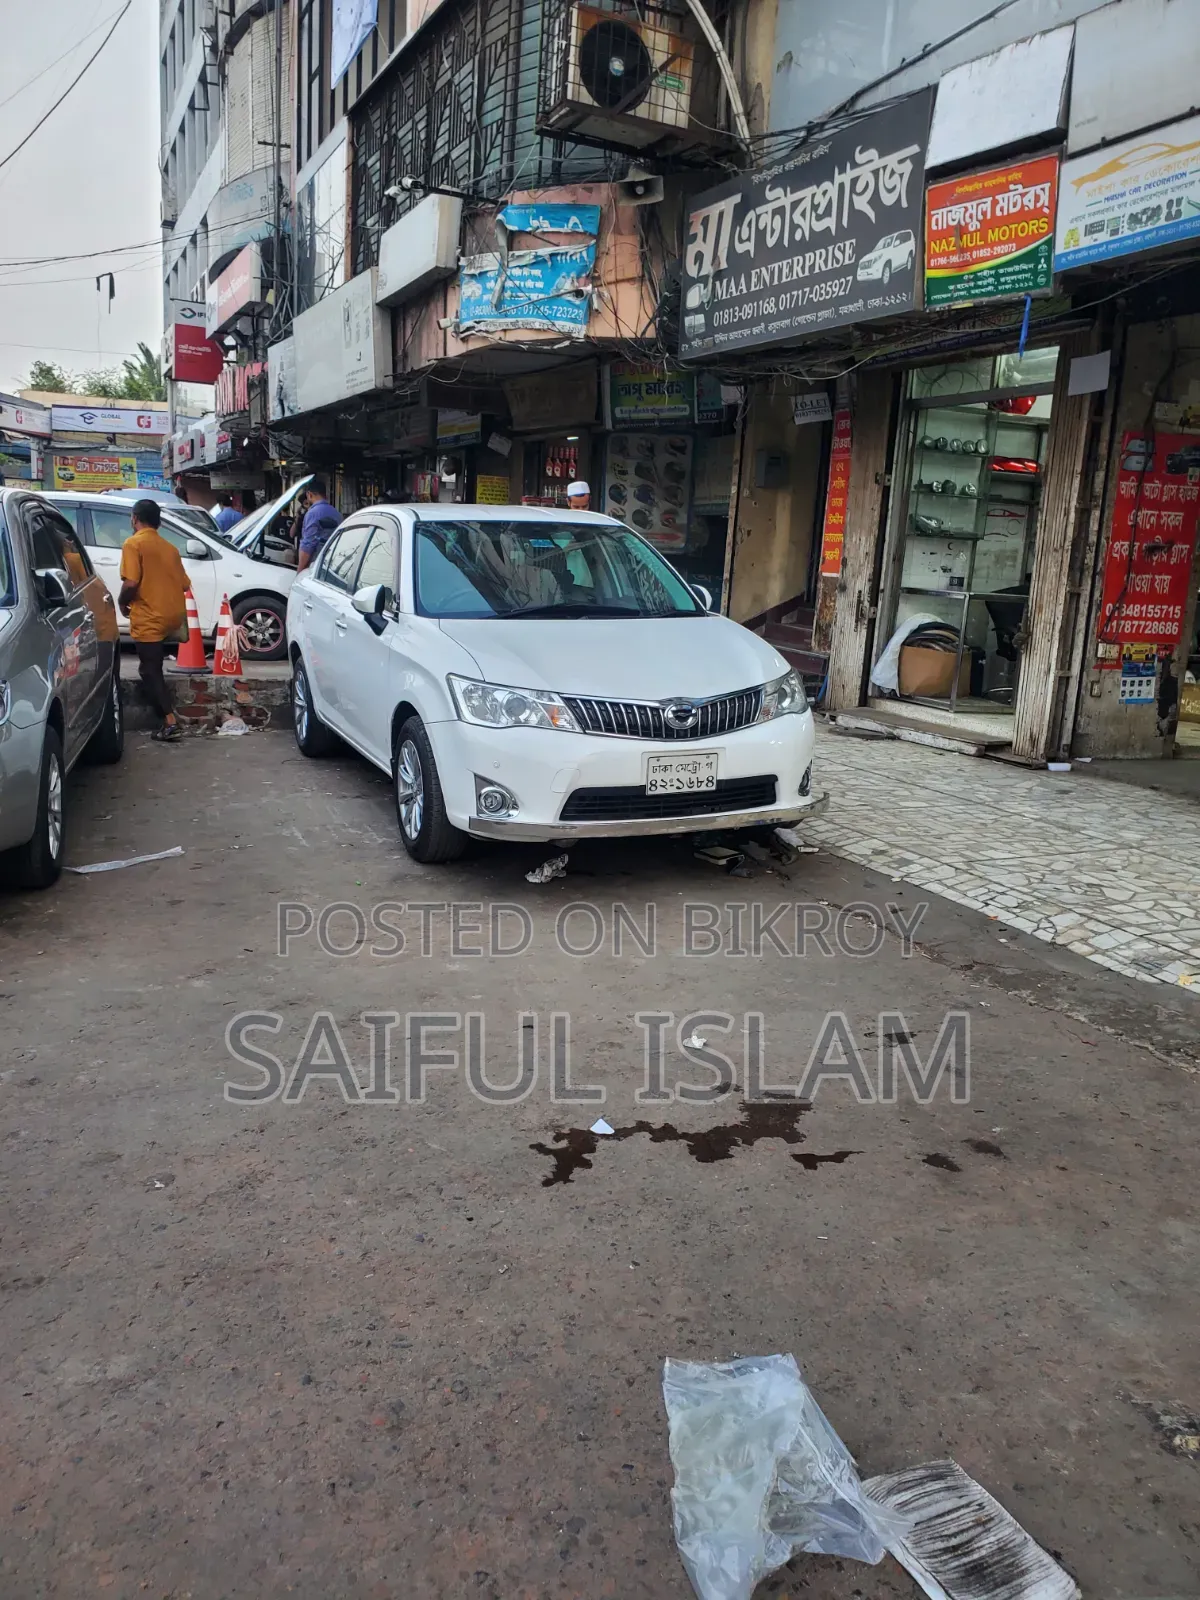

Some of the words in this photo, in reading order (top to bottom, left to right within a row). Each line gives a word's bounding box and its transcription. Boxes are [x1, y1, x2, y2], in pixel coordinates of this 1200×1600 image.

[1128, 185, 1142, 197] CAR
[1143, 171, 1188, 191] DECORATION
[685, 193, 742, 278] মা
[735, 144, 921, 258] এন্টারপ্রাইজ
[931, 197, 993, 231] নাজমুল
[988, 217, 1049, 243] MOTORS
[714, 272, 754, 302] MAA
[751, 239, 856, 292] ENTERPRISE
[713, 297, 777, 327] 01813-091168,
[779, 276, 853, 312] 01717-035927
[1160, 511, 1185, 532] সকল
[1171, 542, 1190, 565] গ্লাস
[652, 764, 673, 774] ঢাকা
